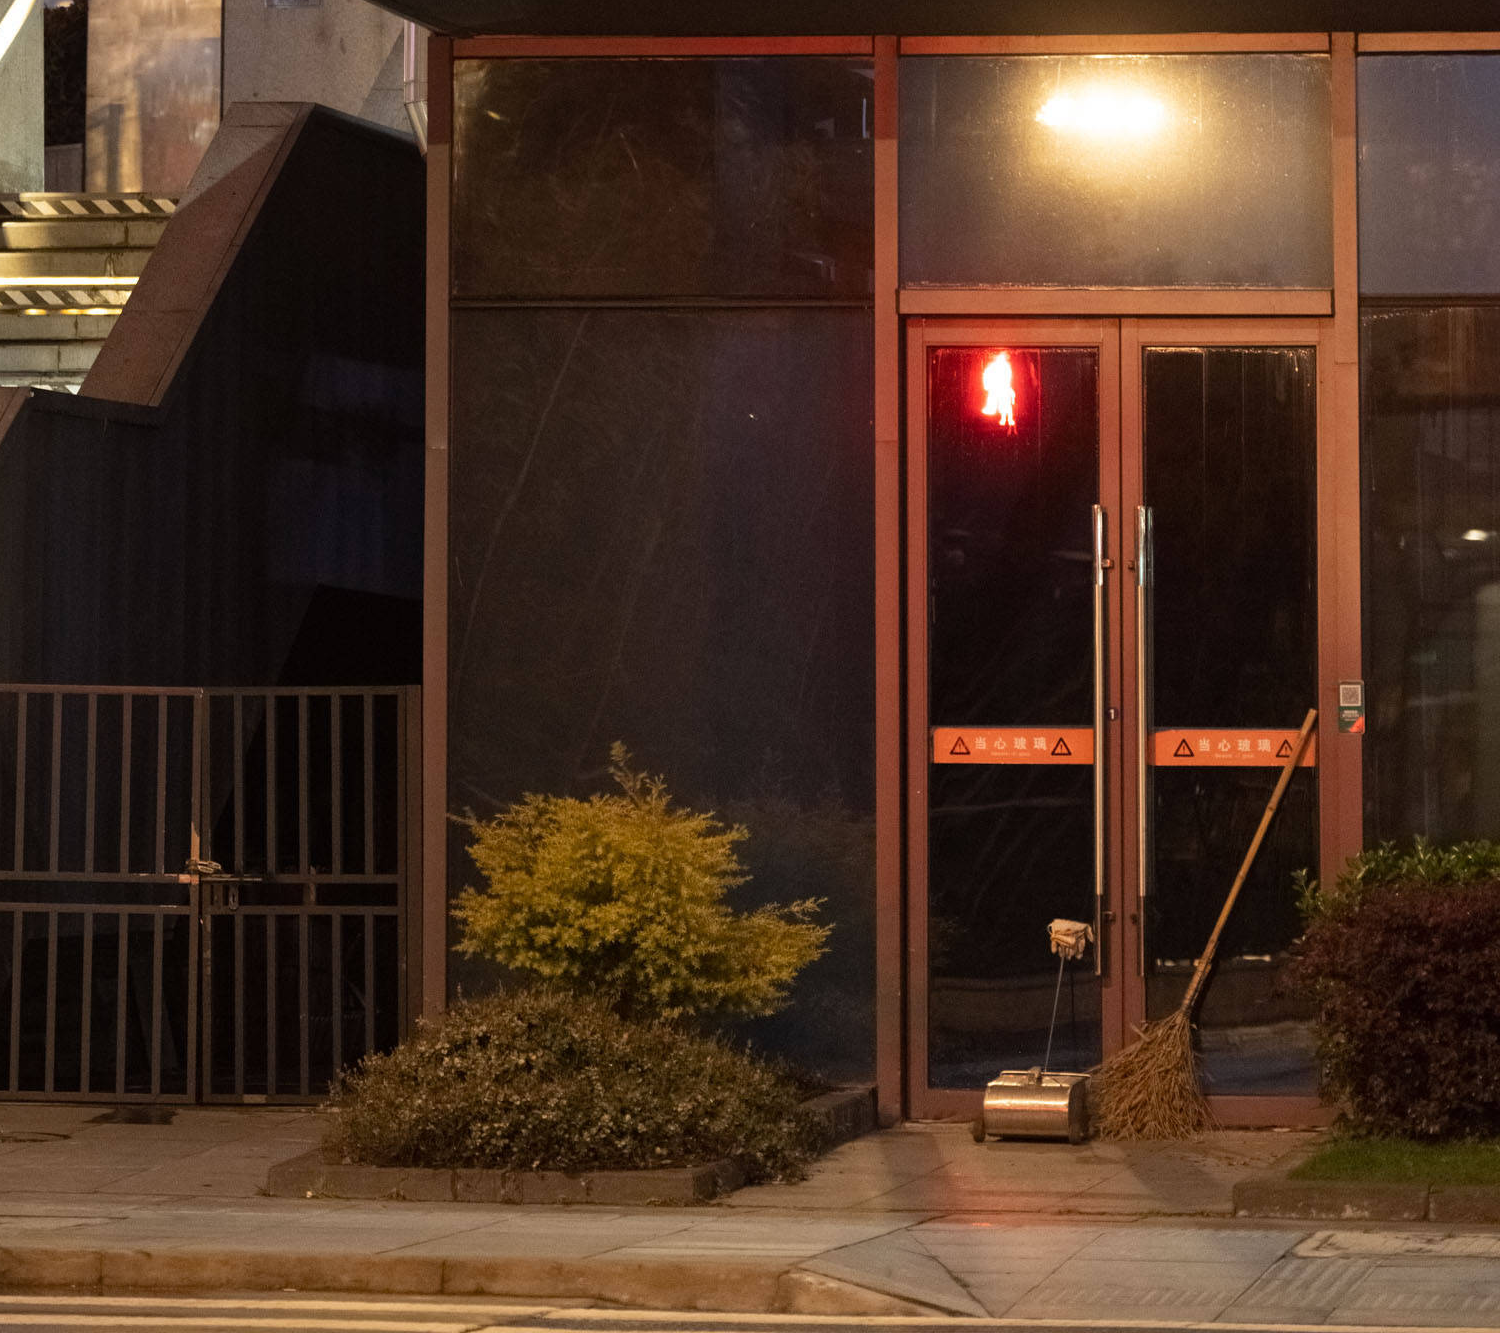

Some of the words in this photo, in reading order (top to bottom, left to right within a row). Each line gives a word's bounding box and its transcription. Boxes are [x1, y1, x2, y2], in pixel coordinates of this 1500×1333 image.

[974, 736, 1048, 751] 当心玻璃
[1198, 738, 1272, 753] 当心玻璃
